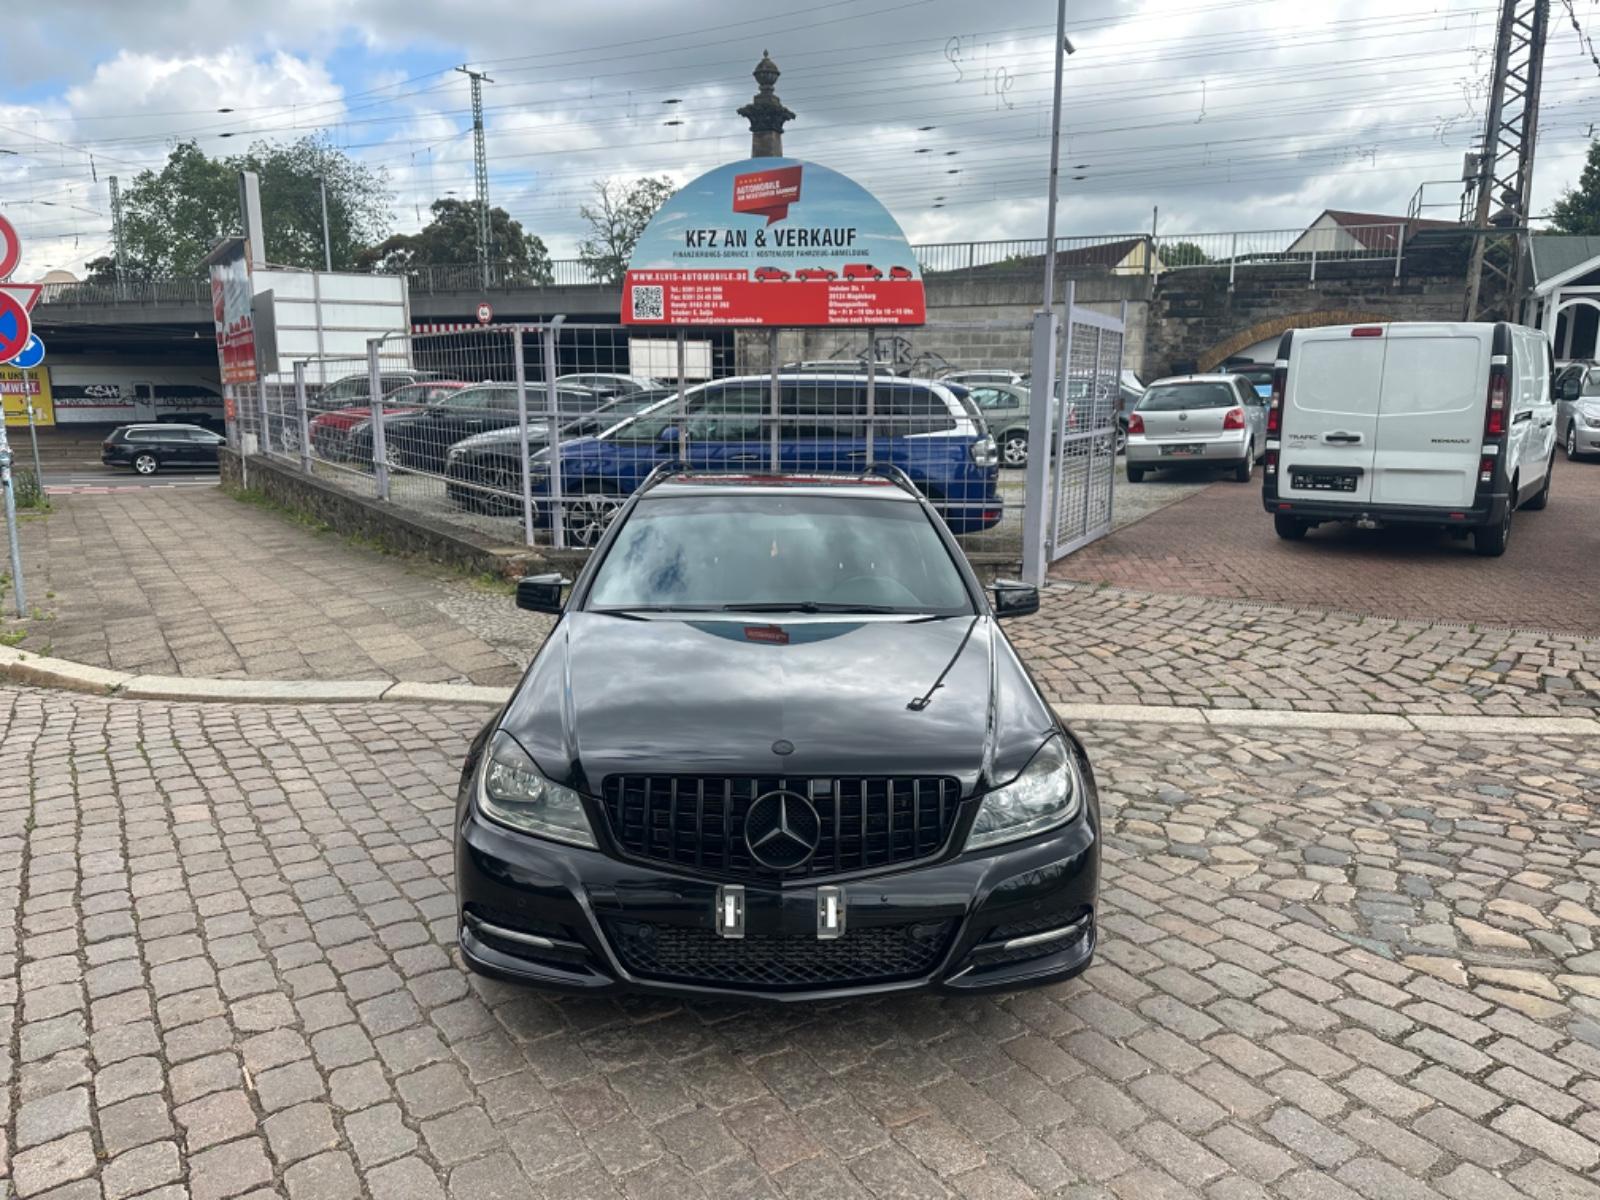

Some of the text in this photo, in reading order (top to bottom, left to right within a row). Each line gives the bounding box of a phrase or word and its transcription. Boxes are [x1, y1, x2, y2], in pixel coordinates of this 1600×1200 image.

[737, 180, 780, 194] AUTOMOBILE
[686, 228, 857, 248] KFZ AN & VERKAUF
[673, 250, 748, 258] FINANZIERUNGS-SERVICE
[797, 249, 870, 257] FAHRZEUG-ABMELDUNG
[632, 273, 747, 281] WWW.ELVIS-AUTOMOBILE.DE
